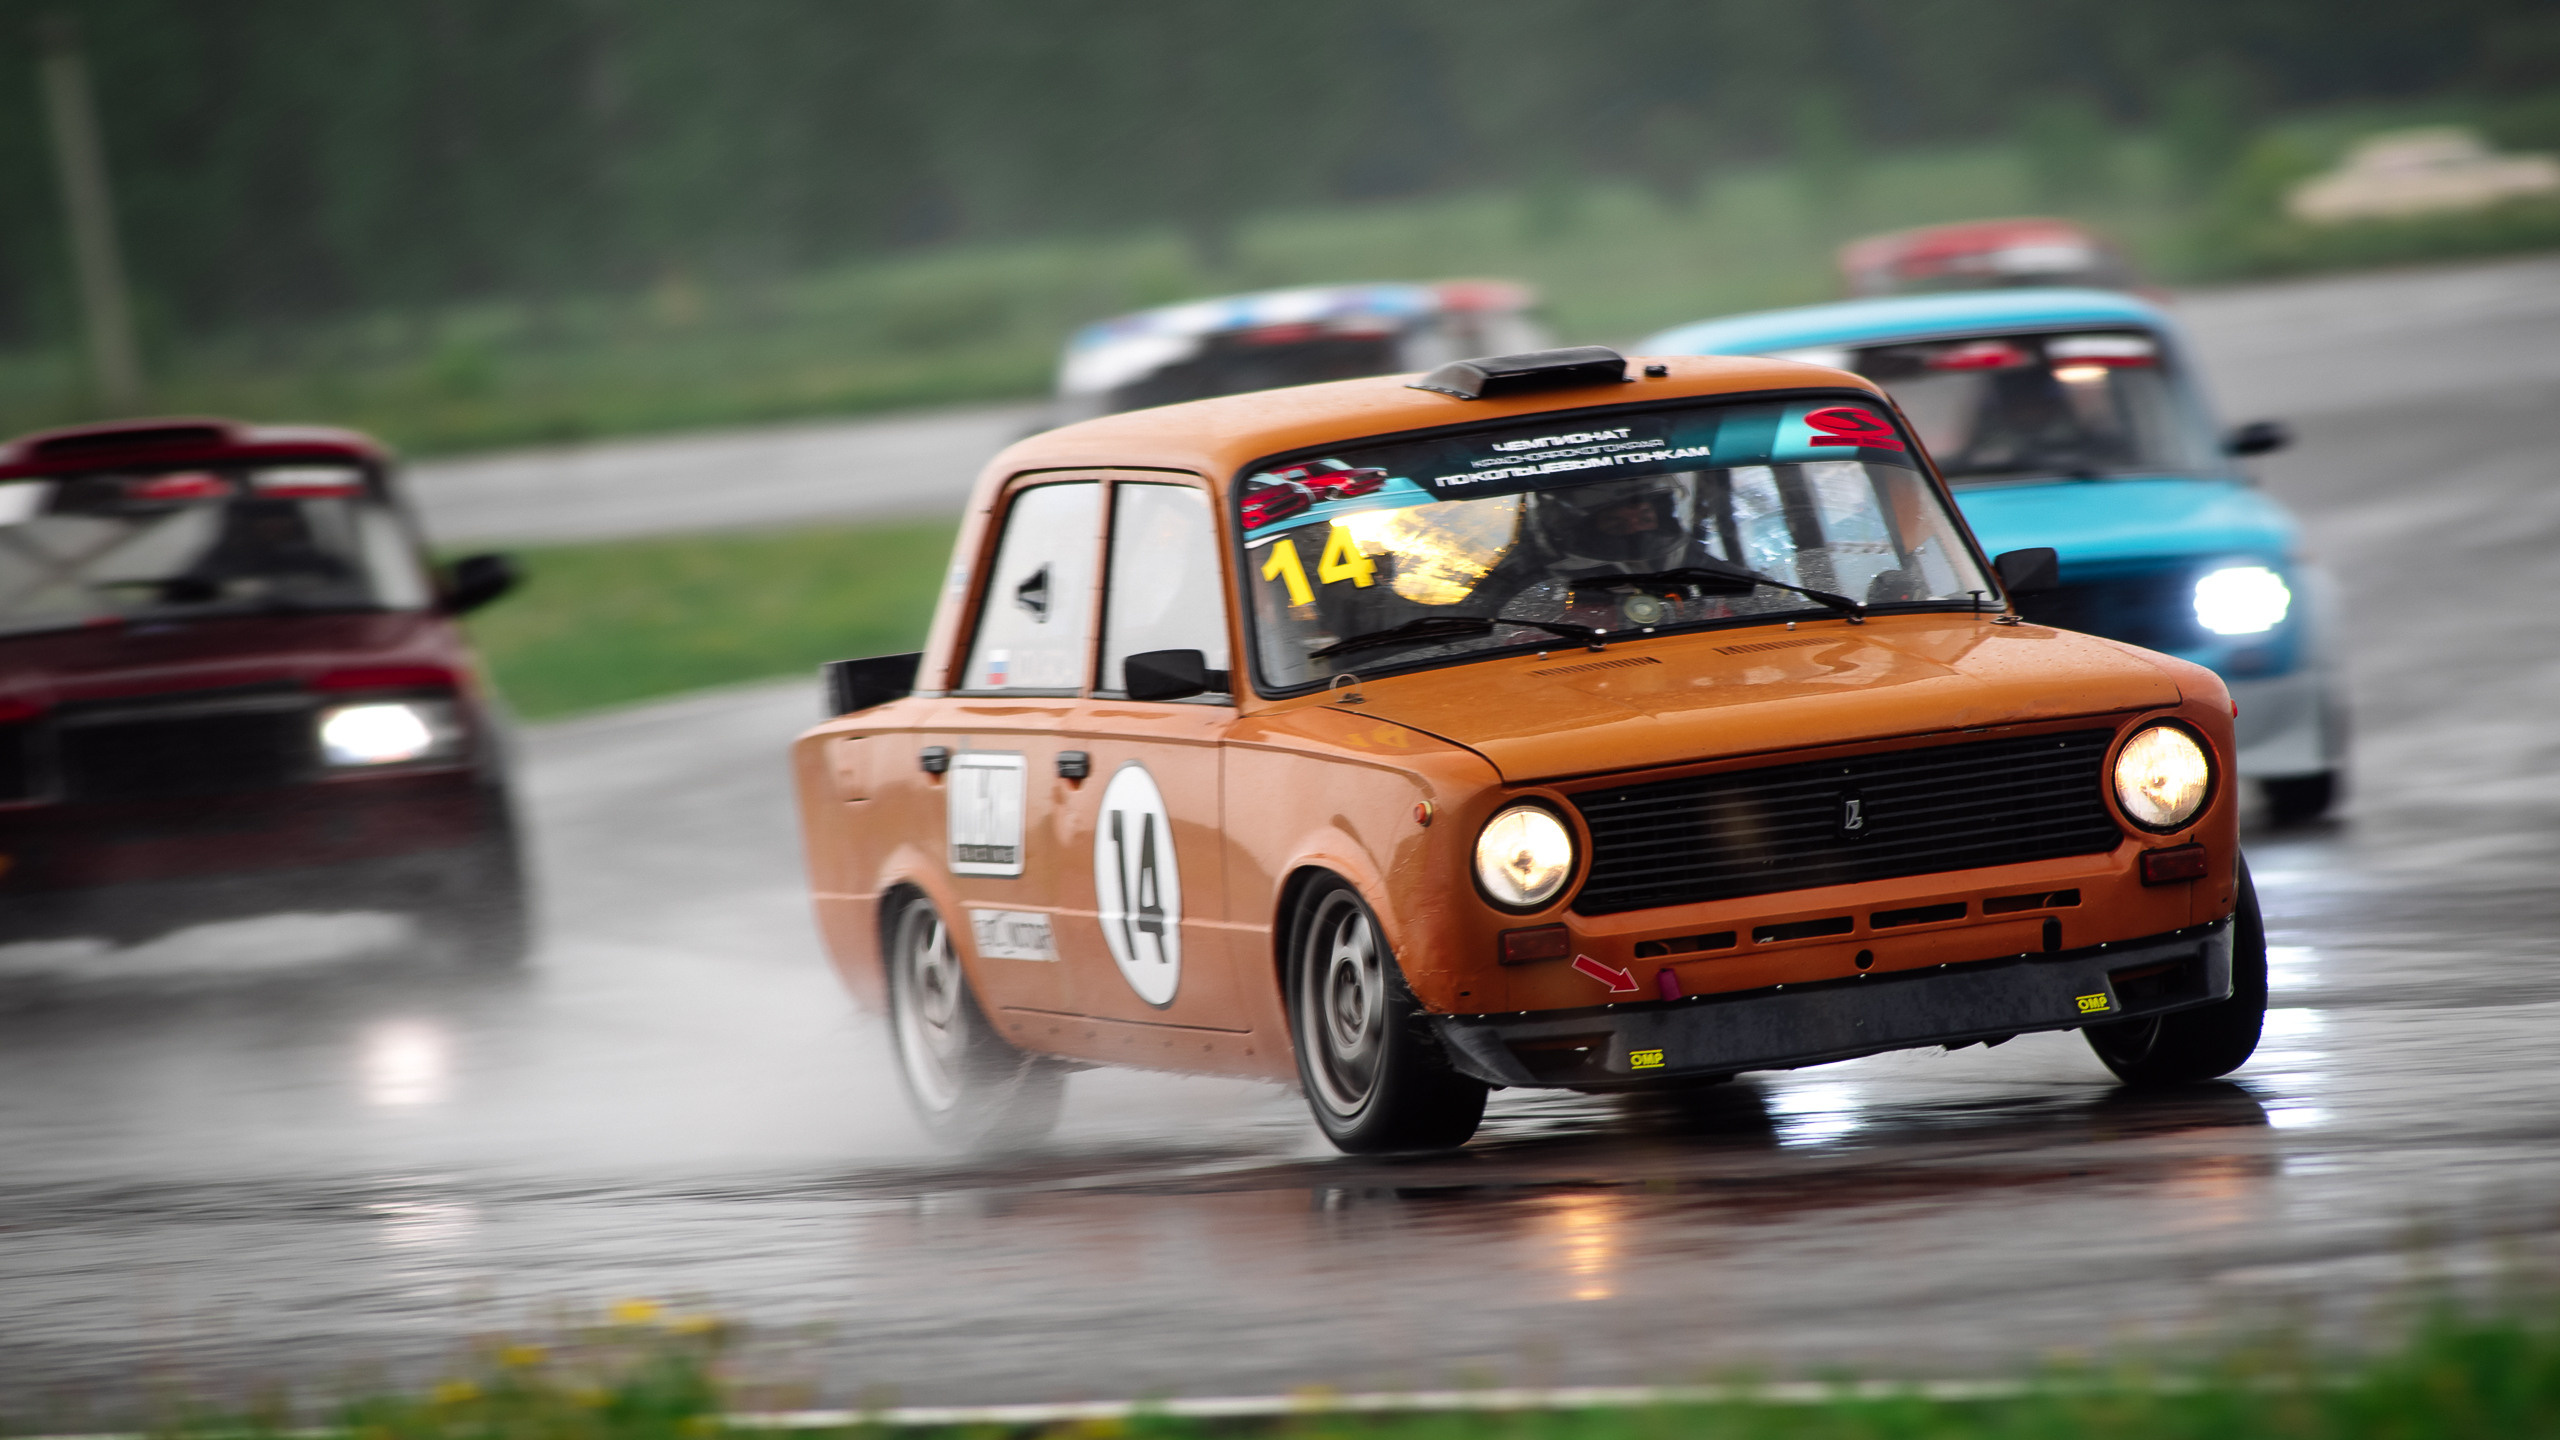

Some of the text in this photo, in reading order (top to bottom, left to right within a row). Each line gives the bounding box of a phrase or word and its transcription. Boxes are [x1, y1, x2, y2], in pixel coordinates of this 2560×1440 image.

[1492, 428, 1631, 452] ЧЕМПИОНАТ
[1434, 446, 1711, 487] ПО КОЛЬЦЕВЫМ ГОНКАМ
[1261, 524, 1378, 606] 14
[1110, 809, 1168, 964] 14
[2077, 995, 2108, 1010] OMP
[1630, 1052, 1664, 1066] OMP
